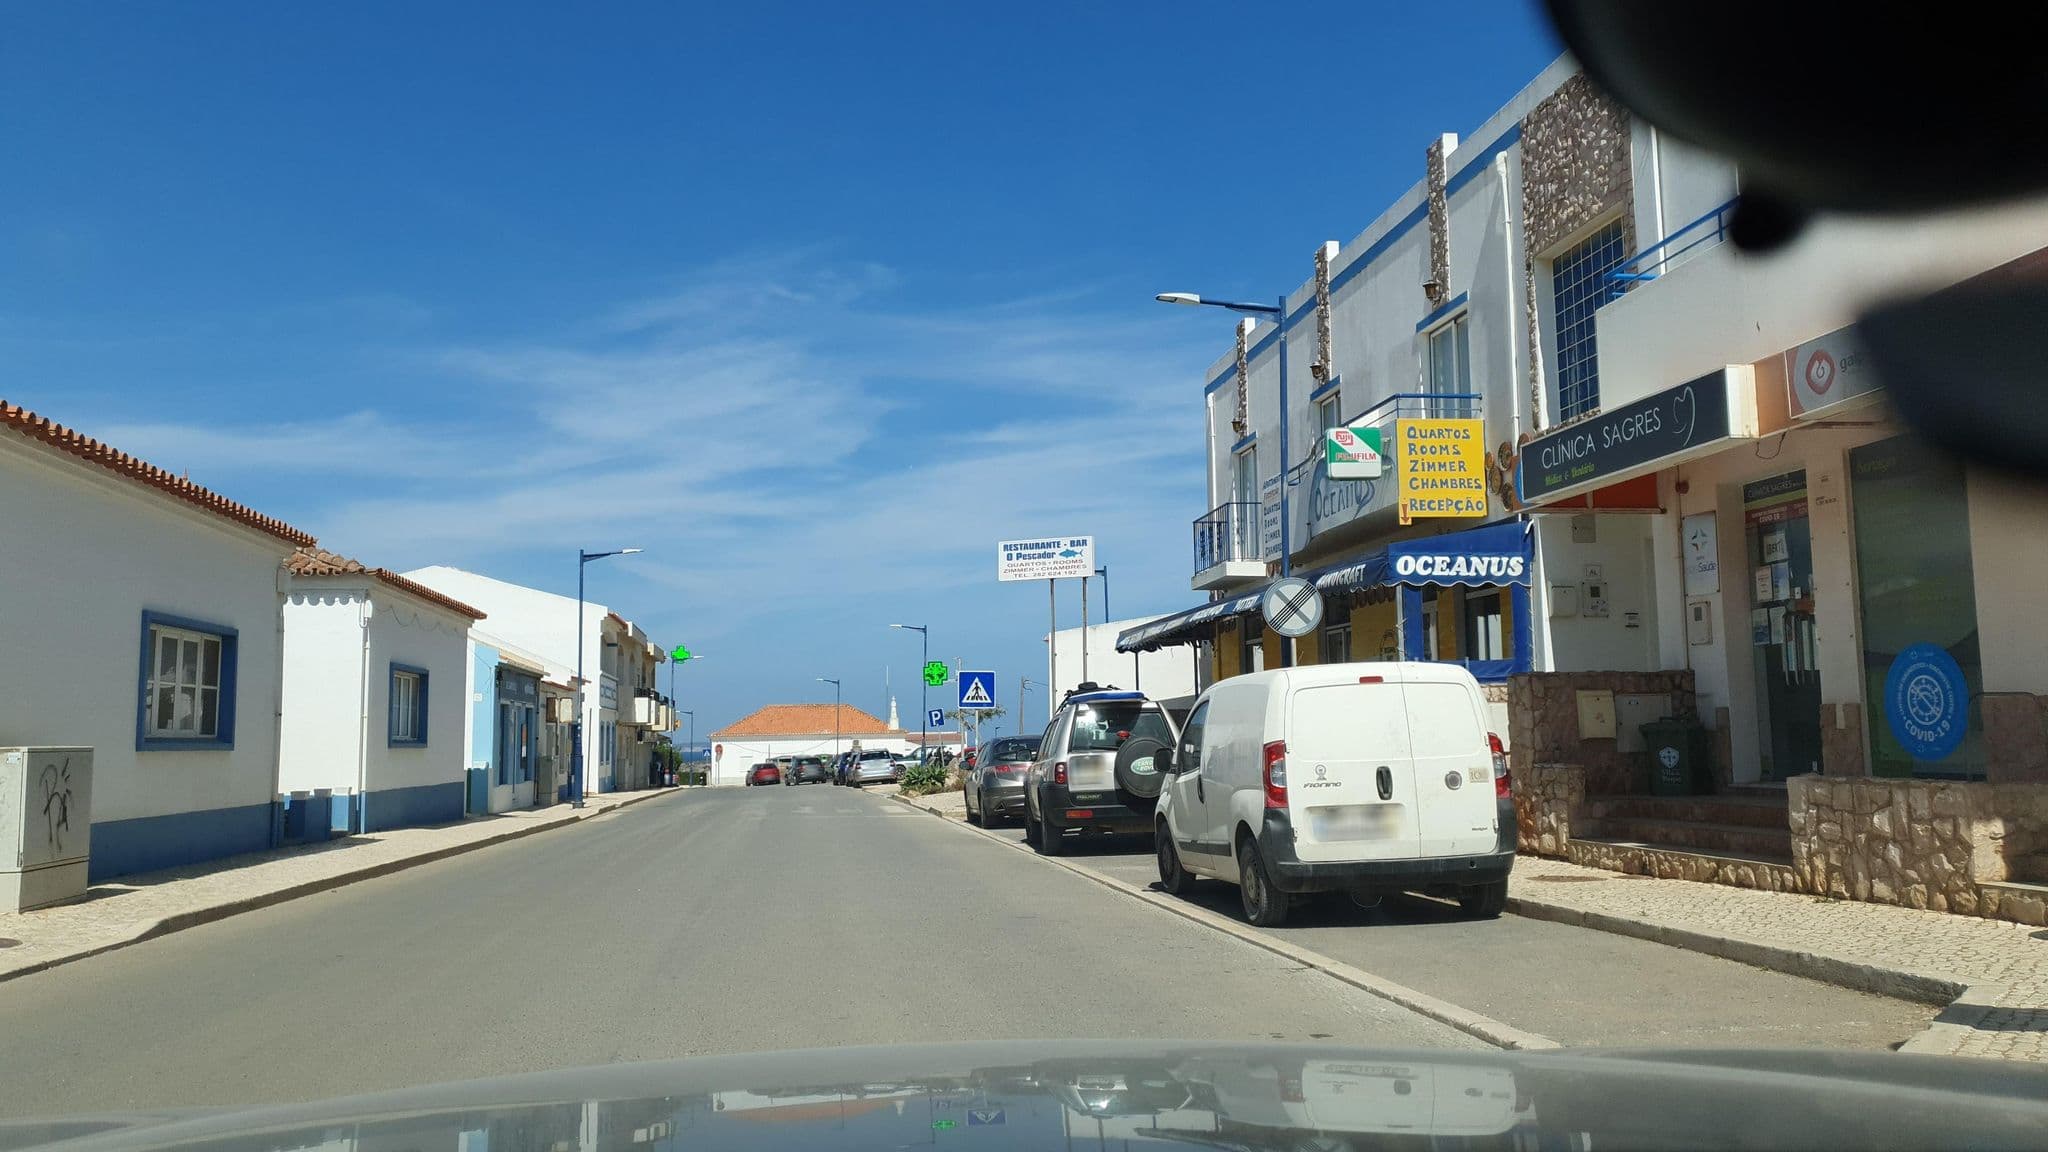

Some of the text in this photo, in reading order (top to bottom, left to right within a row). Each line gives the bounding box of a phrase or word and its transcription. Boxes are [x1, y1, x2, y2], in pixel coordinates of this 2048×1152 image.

[1407, 426, 1471, 440] QUARTOS
[1541, 407, 1662, 469] CLÍNICA SAGRES
[1336, 452, 1377, 460] FUJIFILM
[1408, 443, 1462, 456] ROOMS
[1409, 477, 1483, 490] CHAMBRES
[1409, 496, 1484, 515] RECEPÇÃO
[1003, 539, 1088, 552] RESTAURANTE BAR
[1006, 551, 1056, 561] O Pescador
[1396, 556, 1524, 576] OCEANUS
[931, 711, 941, 726] P
[1905, 719, 1951, 742] COVID-19
